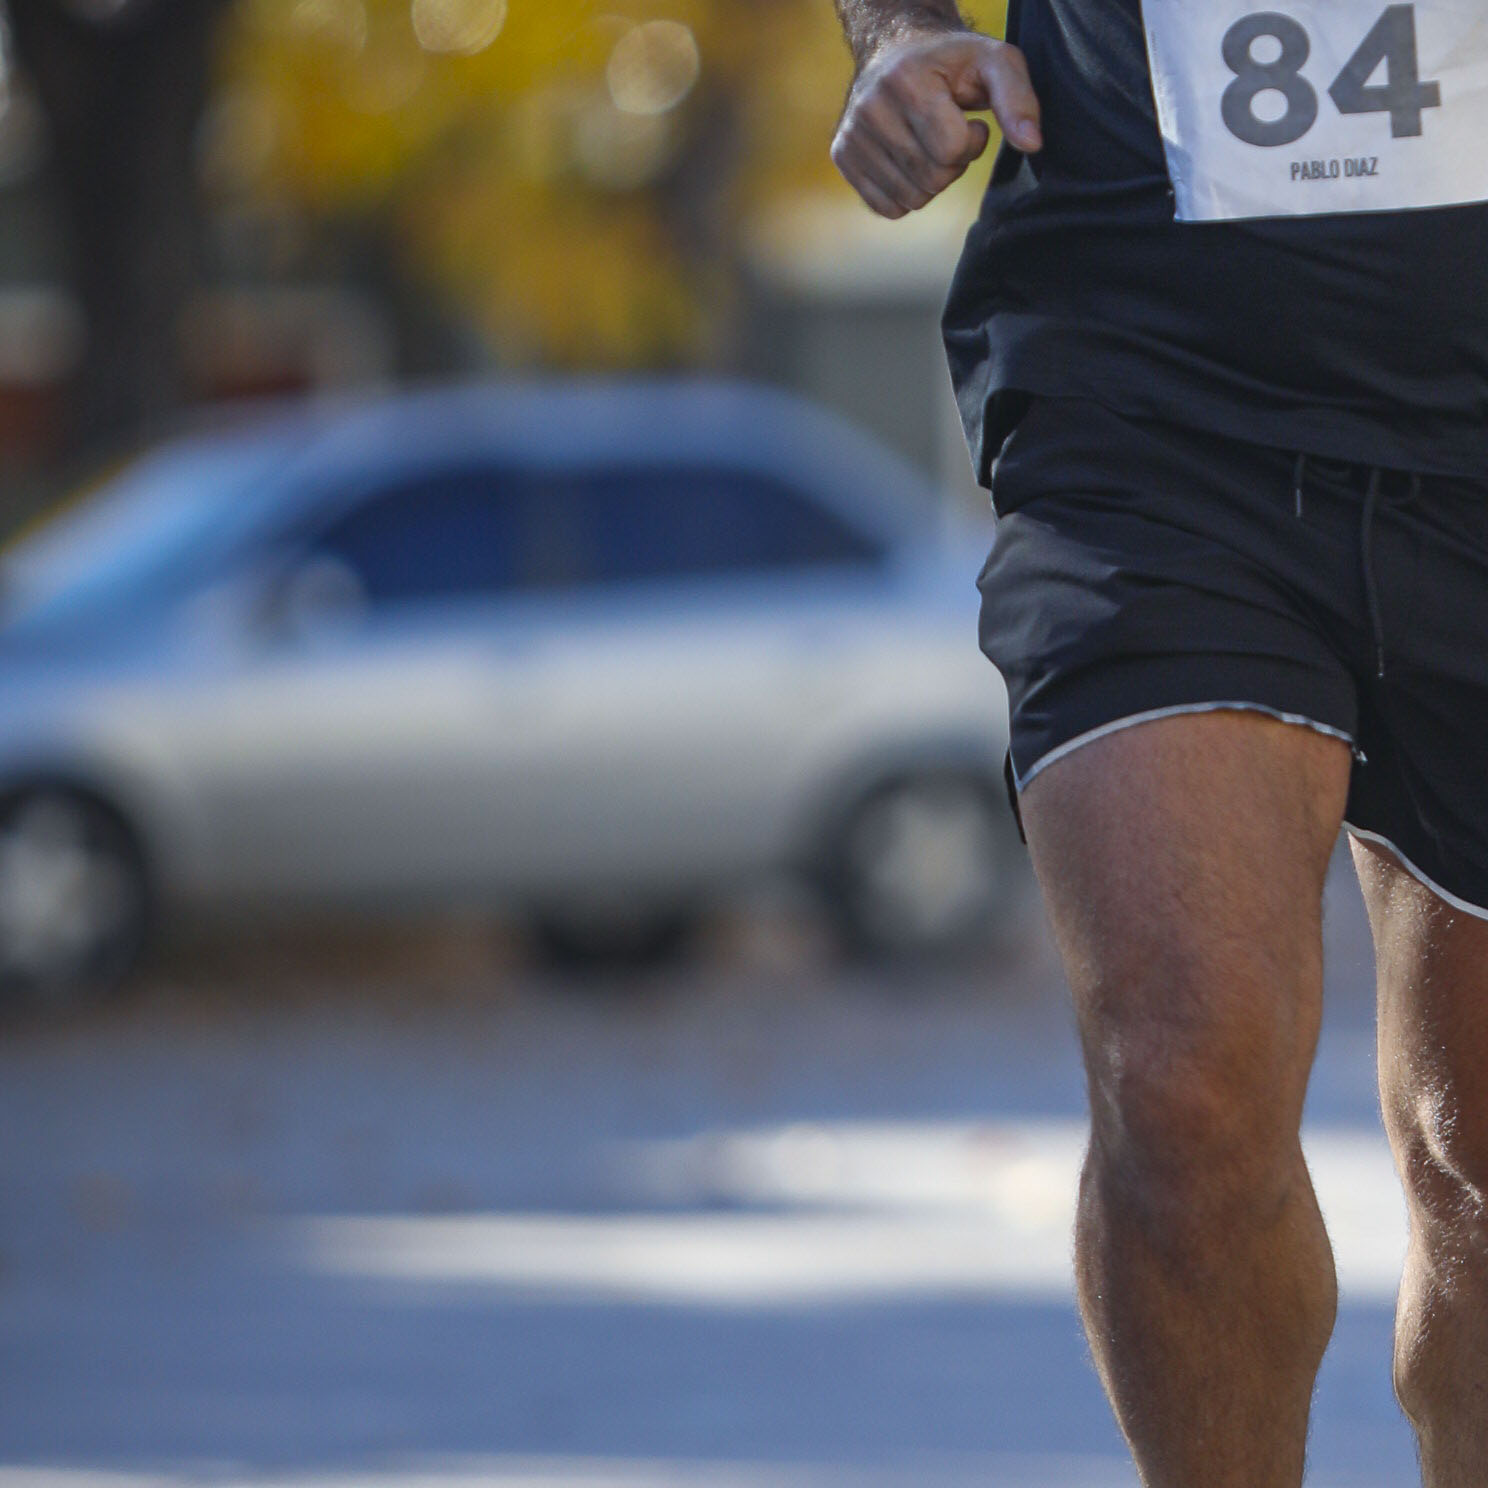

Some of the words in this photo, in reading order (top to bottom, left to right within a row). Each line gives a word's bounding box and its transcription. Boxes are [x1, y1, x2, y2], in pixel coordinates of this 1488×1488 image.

[1220, 2, 1442, 147] 84
[1291, 158, 1340, 181] PABLO
[1344, 156, 1379, 178] DIAZ
